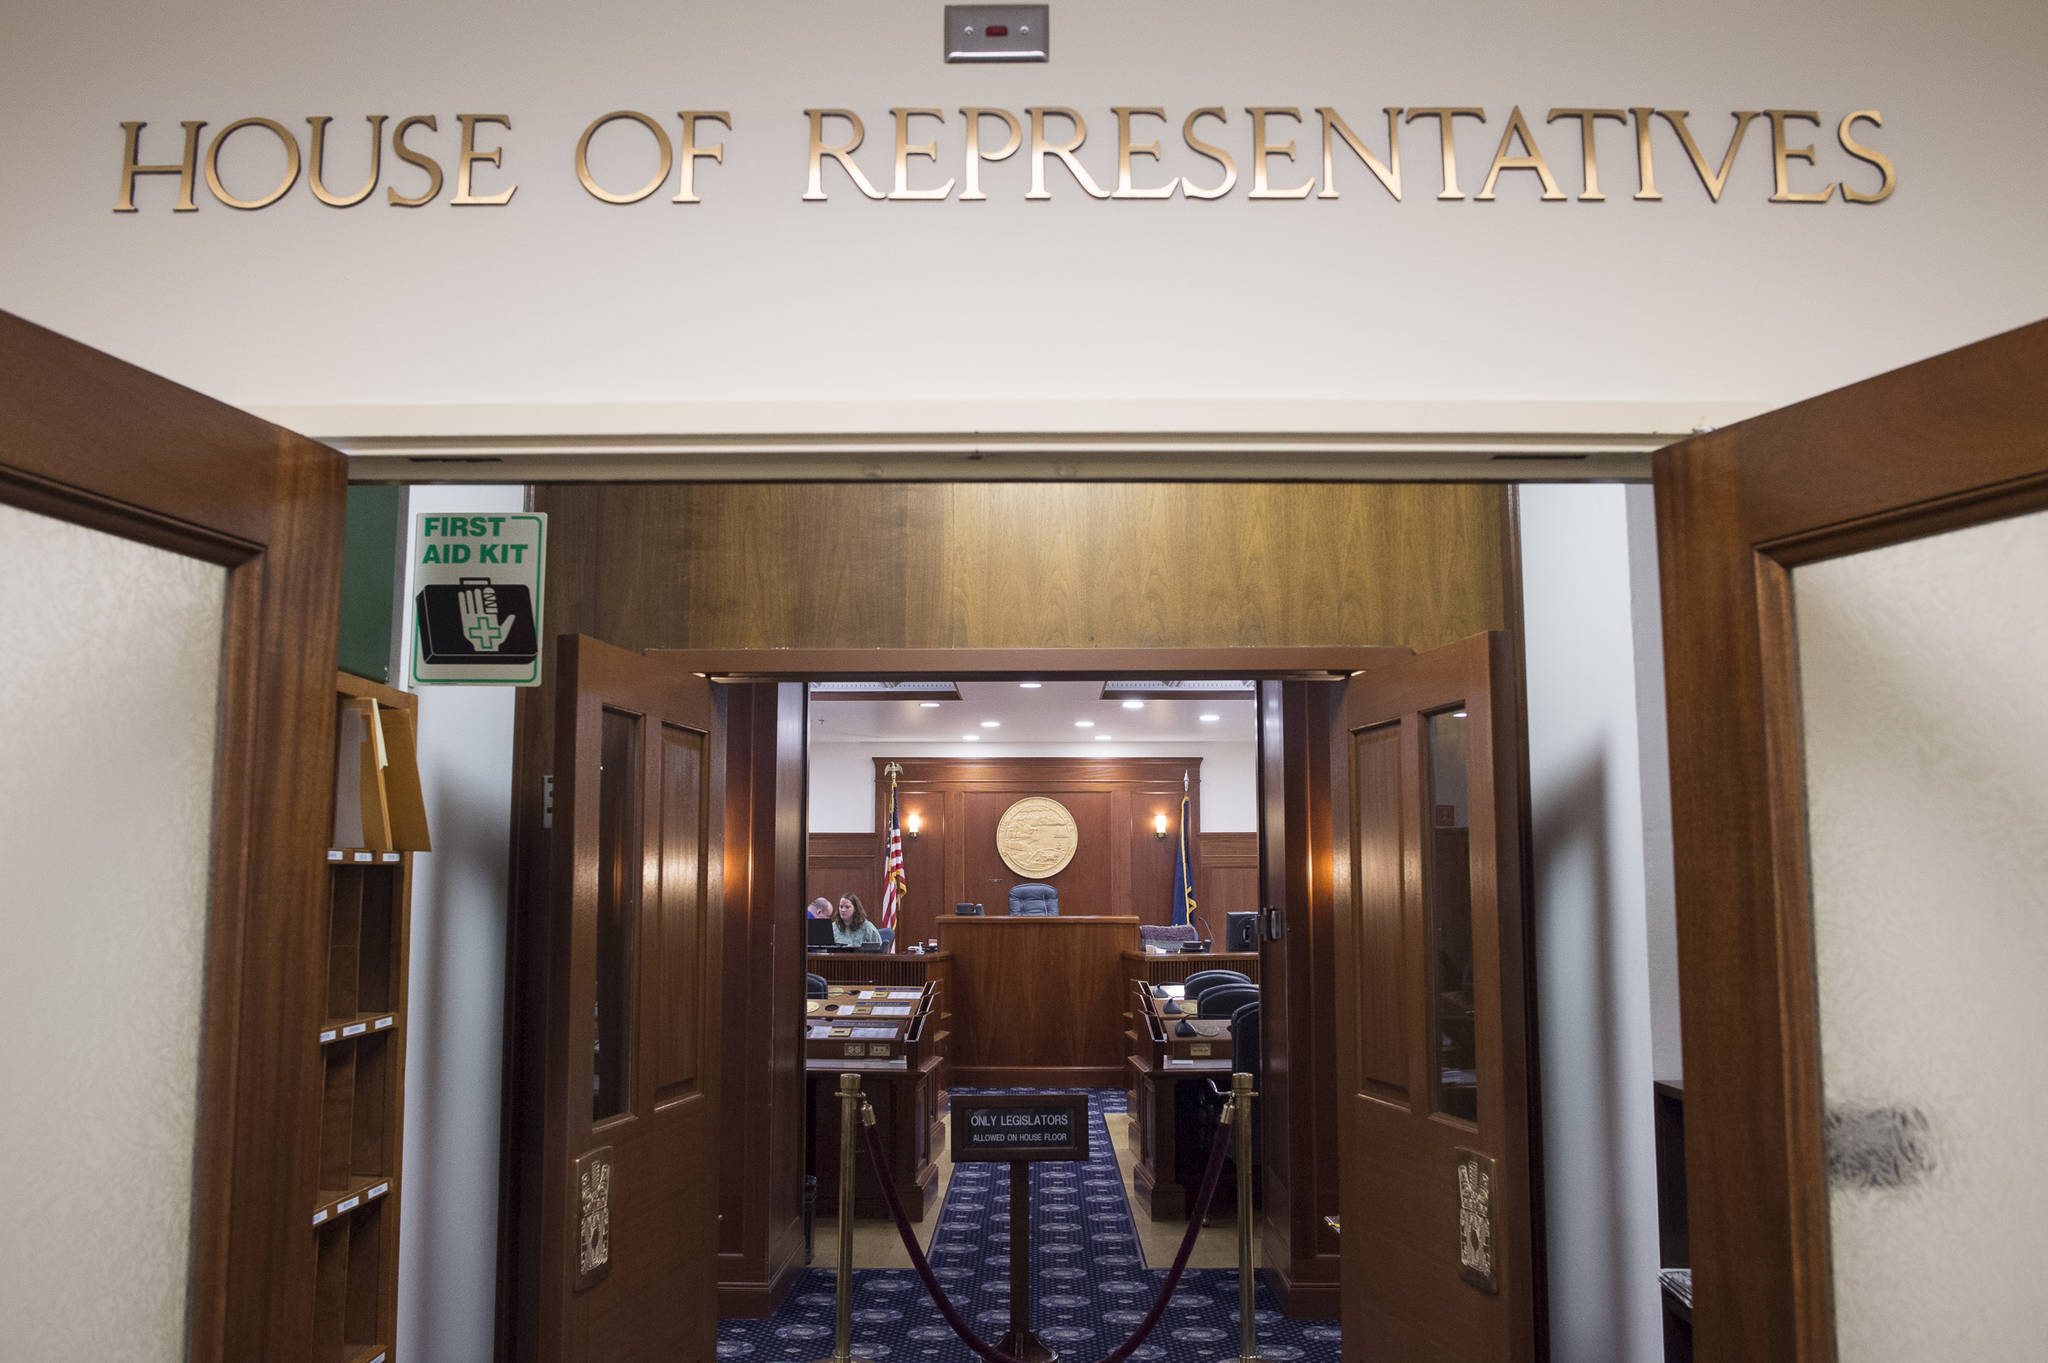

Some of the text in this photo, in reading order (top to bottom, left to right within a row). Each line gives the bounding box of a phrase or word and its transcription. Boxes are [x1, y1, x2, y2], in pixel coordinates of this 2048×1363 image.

[113, 105, 1898, 212] HOUSE OF REPRESENTATIVES
[424, 517, 506, 536] FIRST
[422, 543, 529, 564] AID KIT
[970, 1115, 1068, 1126] ONLY LEGISLATORS
[973, 1133, 1067, 1141] ALLOWED ON HOUSE FLOOR
